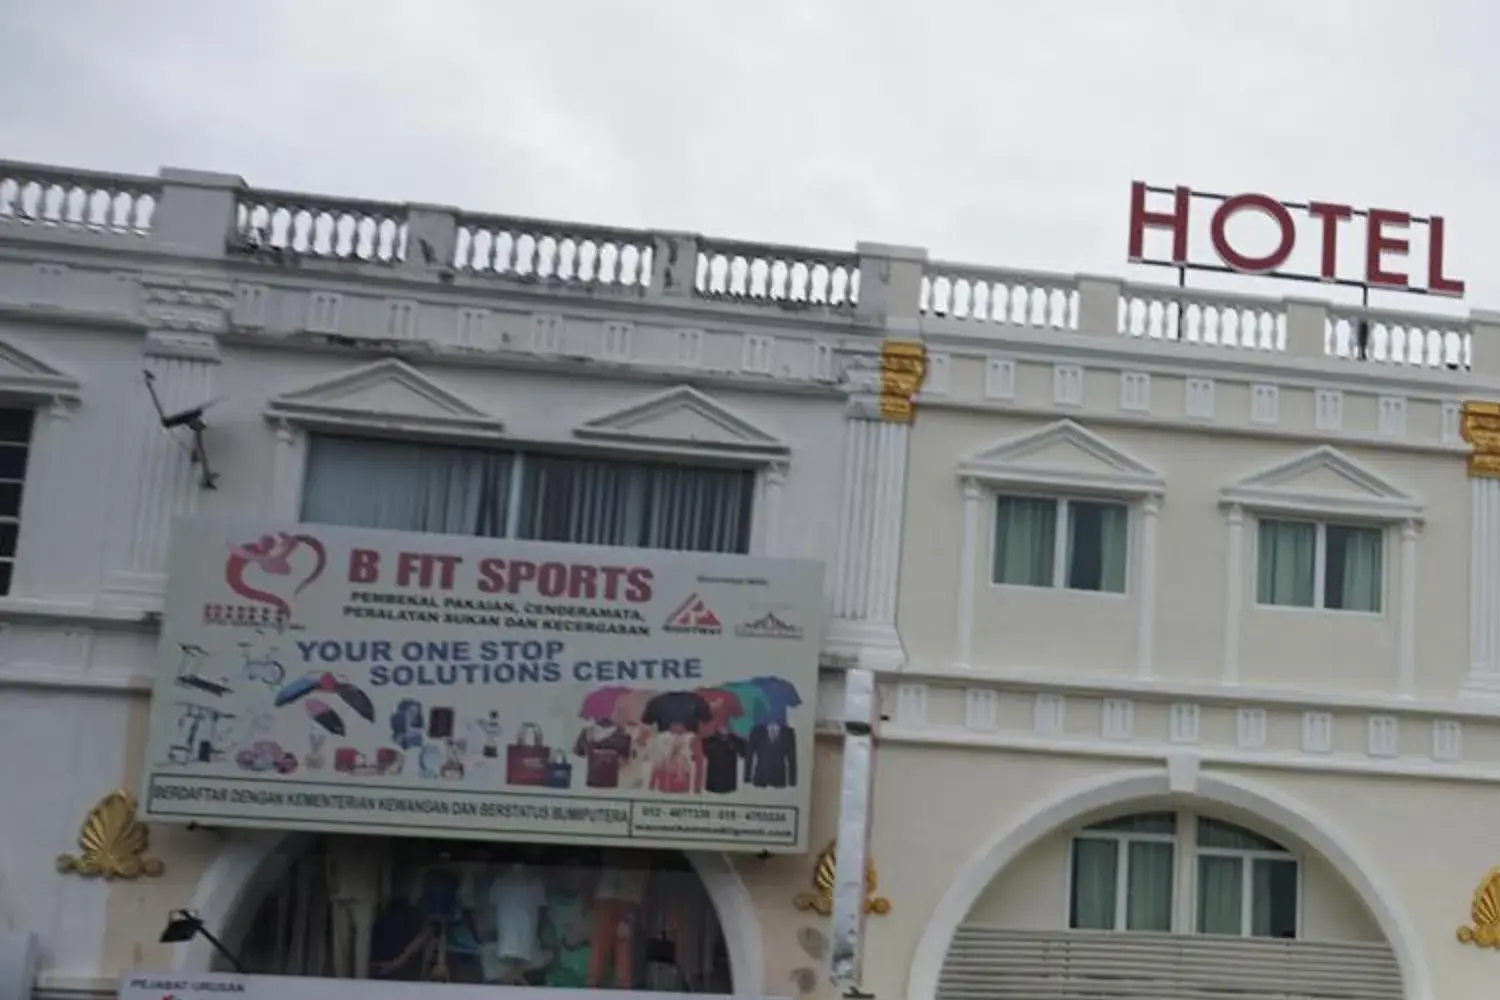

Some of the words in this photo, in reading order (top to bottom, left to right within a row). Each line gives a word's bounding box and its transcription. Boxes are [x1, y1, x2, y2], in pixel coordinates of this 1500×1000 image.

[1127, 180, 1466, 296] HOTEL
[348, 549, 381, 584] B
[396, 552, 463, 590] FIT
[477, 558, 655, 603] SPORTS
[351, 591, 438, 608] PEMBEKAL
[343, 605, 439, 625] PERALATAN
[443, 613, 499, 628] SUKAN
[504, 616, 537, 630] DAN
[541, 618, 650, 637] KECERGASAN
[297, 640, 393, 663] YOUR
[401, 641, 471, 663] ONE
[480, 641, 565, 663] STOP
[370, 661, 562, 687] SOLUTIONS
[573, 657, 703, 683] CENTRE
[452, 802, 476, 816] DAN
